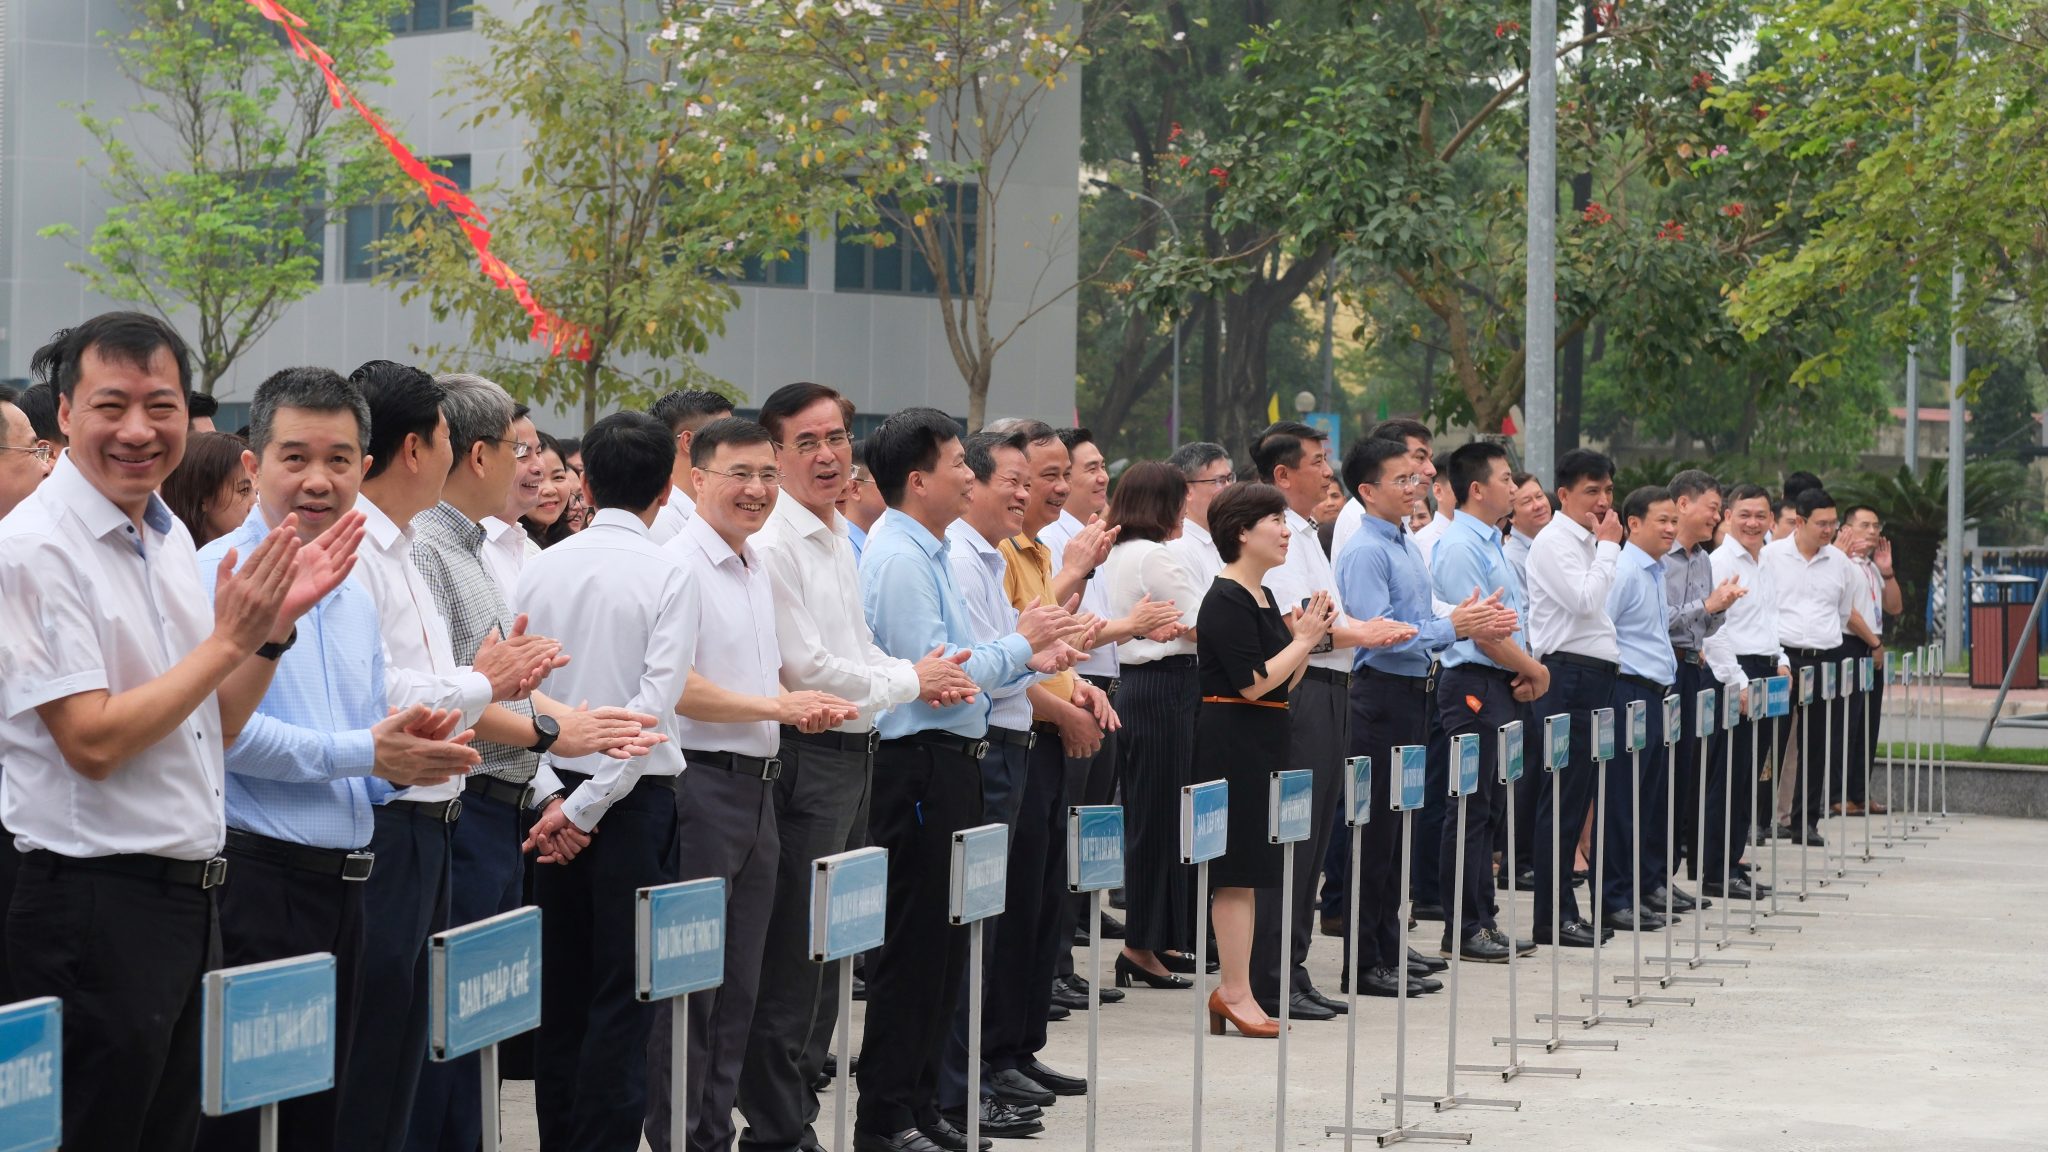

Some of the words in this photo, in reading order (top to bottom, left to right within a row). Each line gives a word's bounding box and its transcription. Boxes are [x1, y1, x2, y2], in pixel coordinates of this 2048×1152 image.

[459, 976, 480, 1019] BAN
[482, 961, 509, 1008] PHÁP
[511, 947, 530, 996] CHẾ
